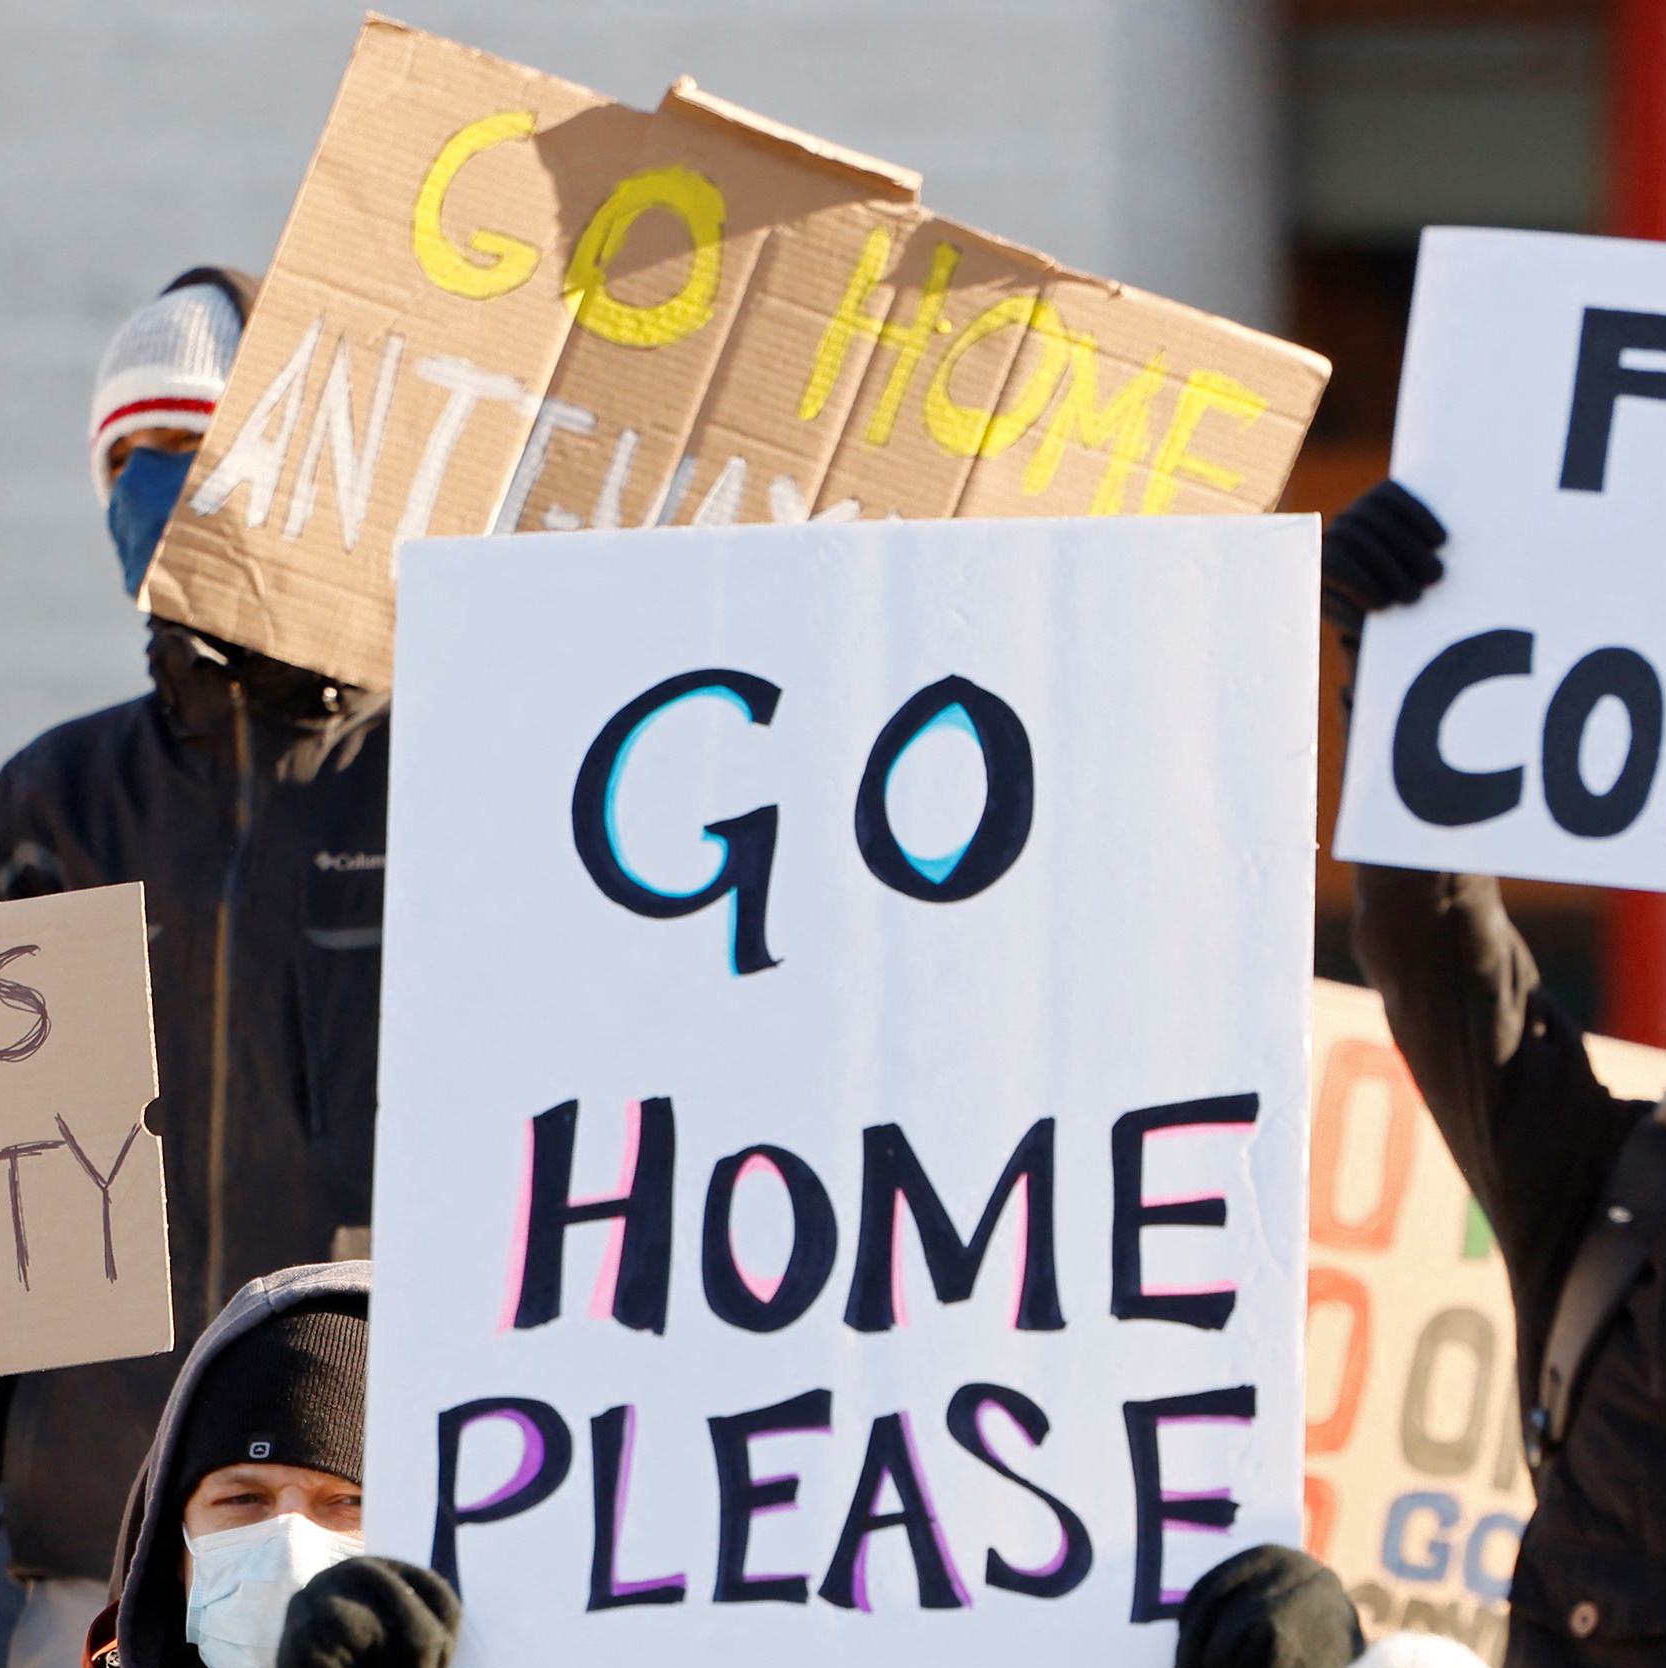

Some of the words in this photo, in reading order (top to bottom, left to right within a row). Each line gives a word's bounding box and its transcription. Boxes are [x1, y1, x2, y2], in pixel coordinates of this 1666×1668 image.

[411, 110, 726, 349] GO
[569, 667, 1036, 977] GO
[496, 1090, 1261, 1338] HOME
[429, 1382, 1259, 1624] PLEASE
